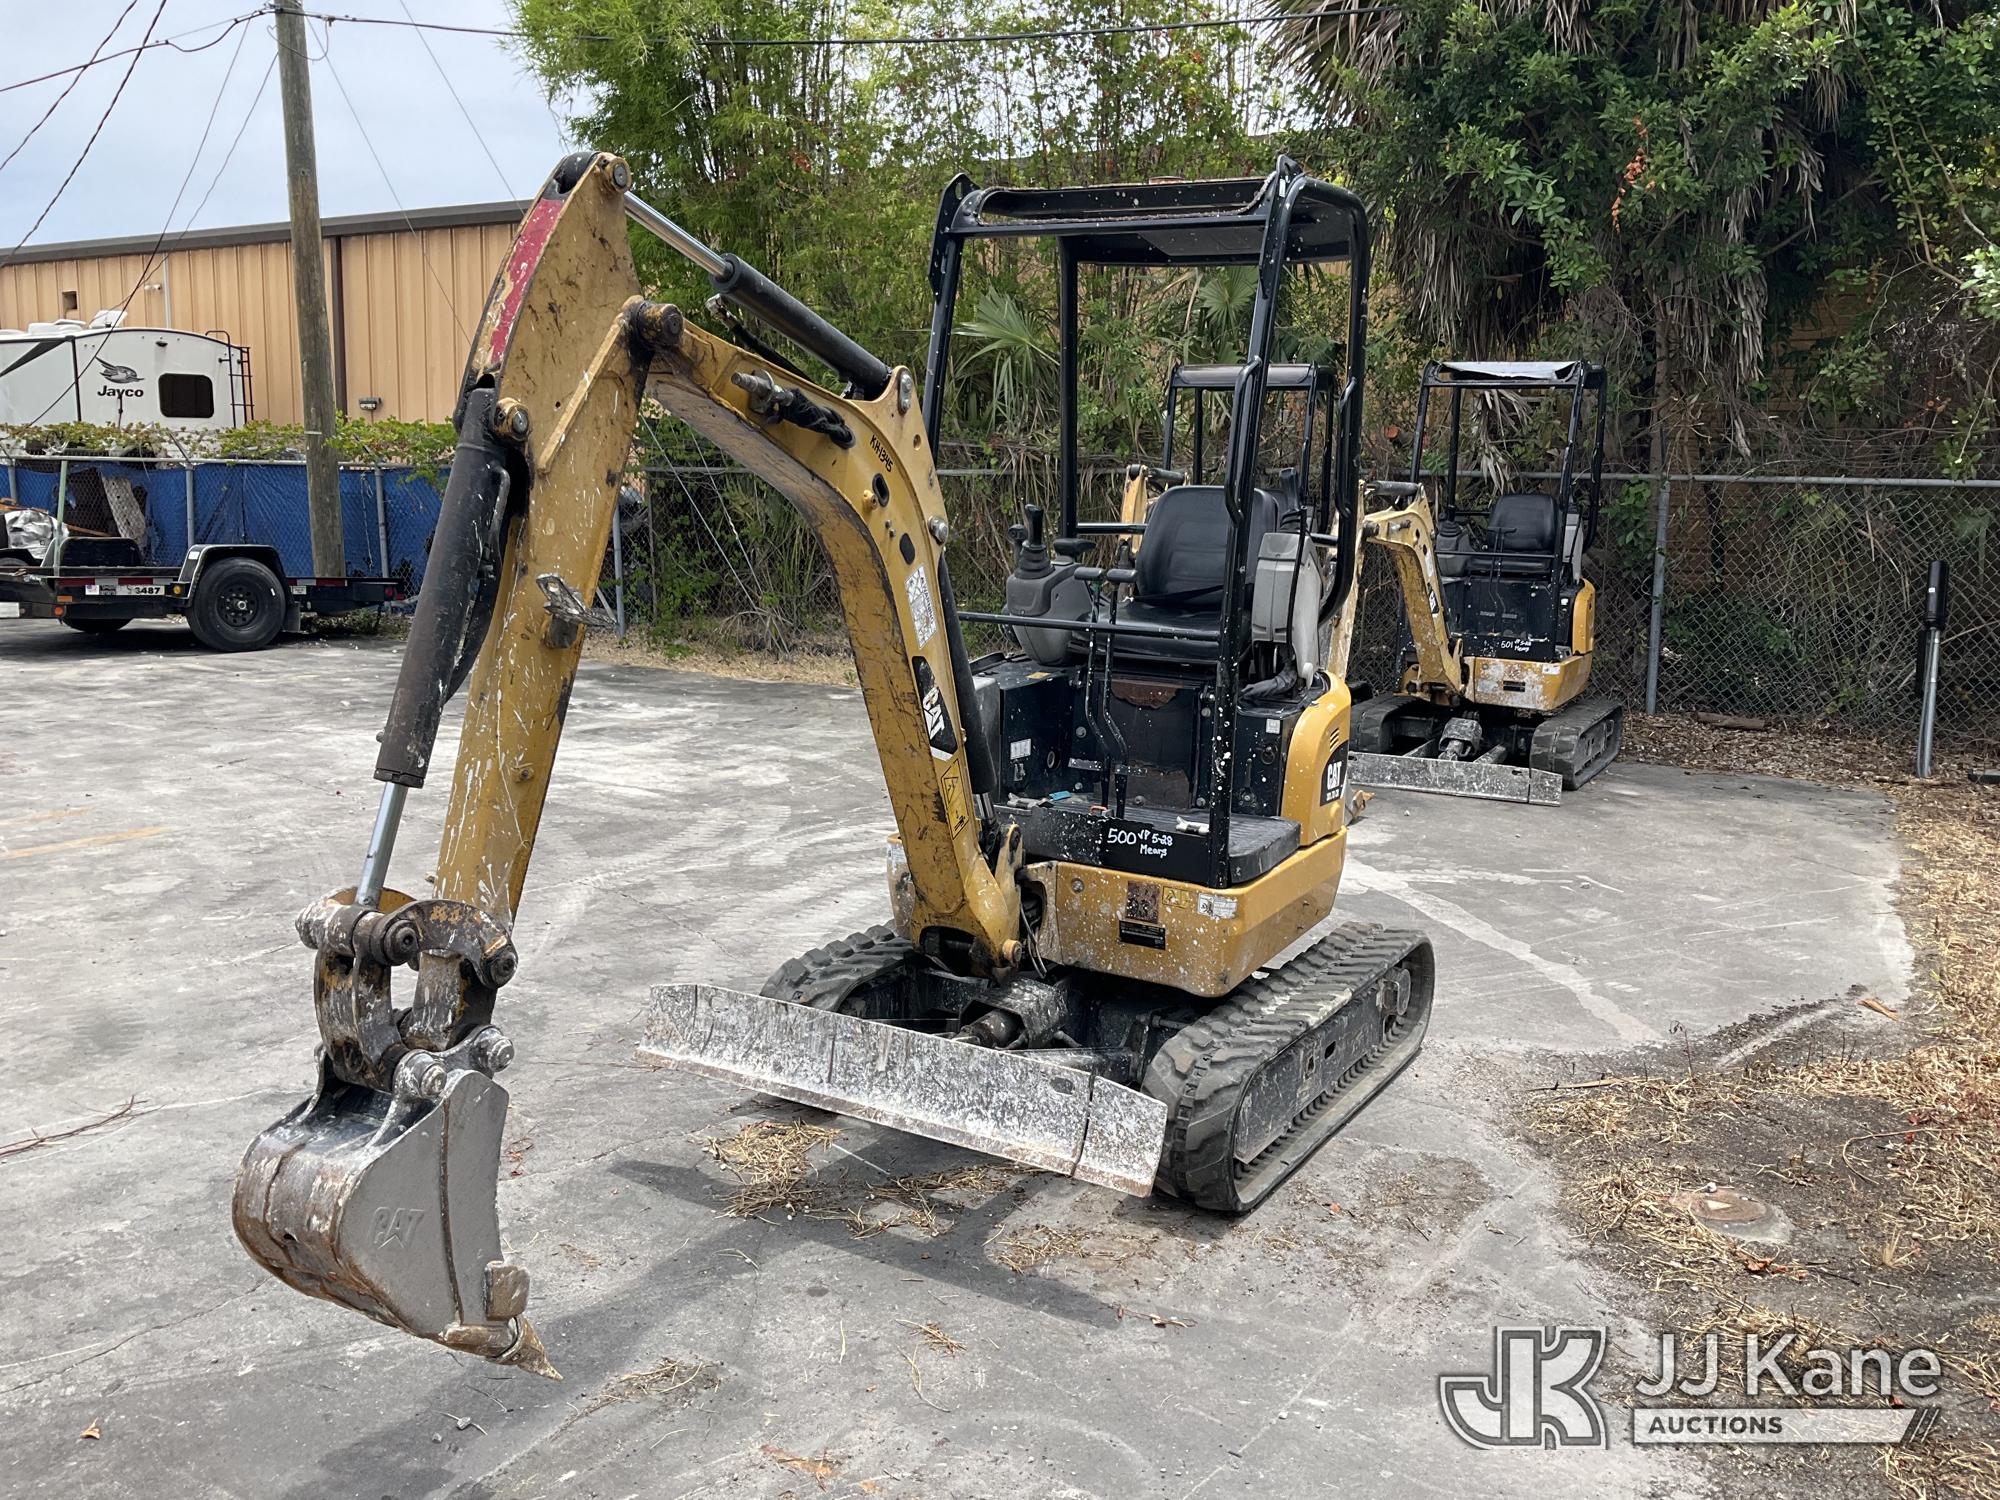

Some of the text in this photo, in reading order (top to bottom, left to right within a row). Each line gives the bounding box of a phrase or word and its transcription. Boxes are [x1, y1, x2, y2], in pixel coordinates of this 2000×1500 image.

[97, 385, 144, 399] Jayco
[923, 686, 945, 740] CAT
[1327, 761, 1342, 790] CAT
[1107, 828, 1137, 844] 500
[1152, 833, 1173, 846] 5-28
[368, 1206, 424, 1249] CAT
